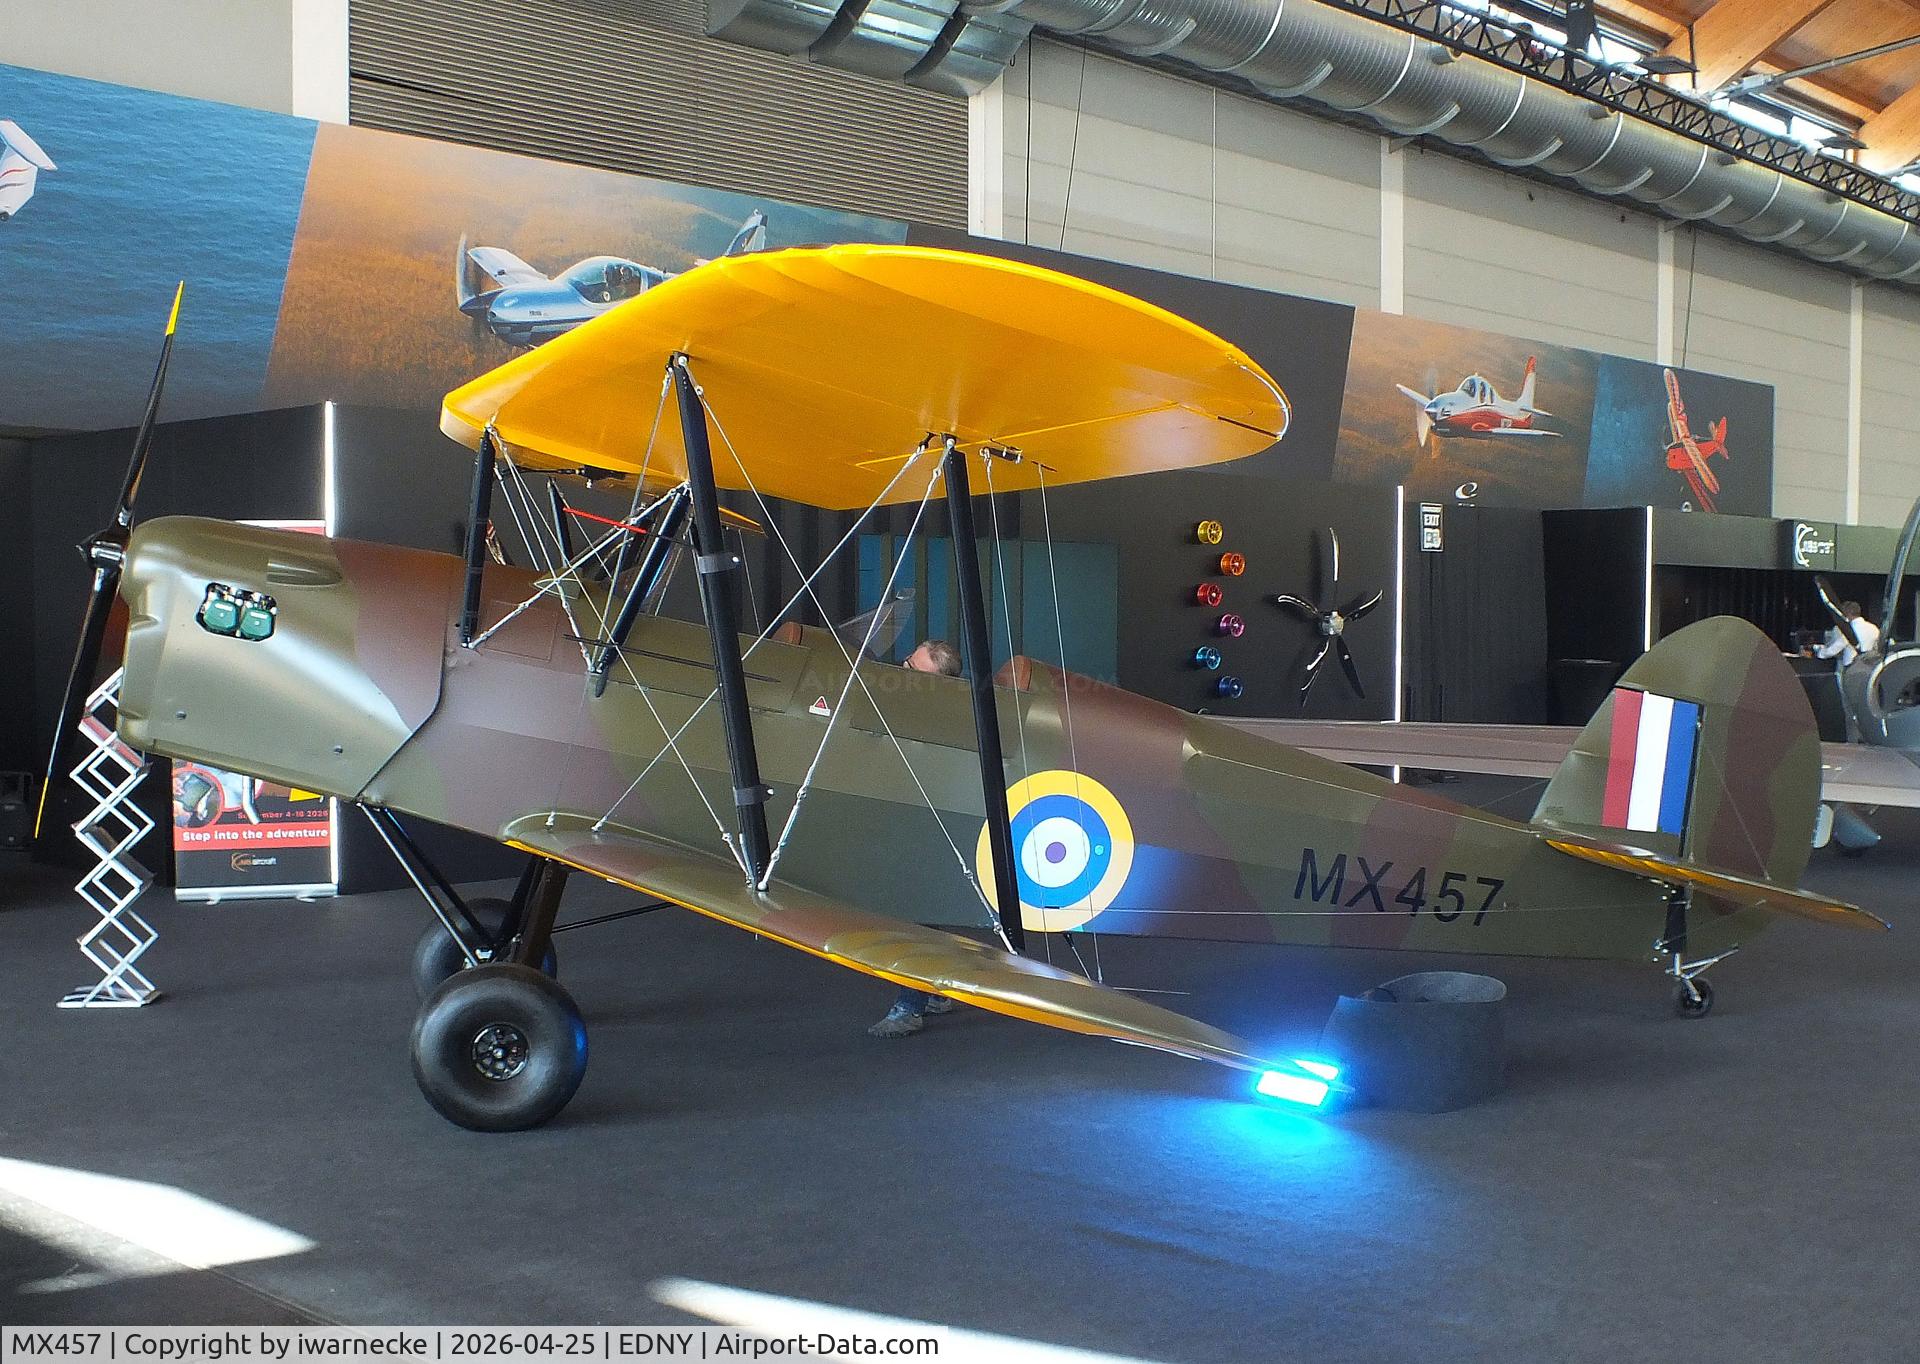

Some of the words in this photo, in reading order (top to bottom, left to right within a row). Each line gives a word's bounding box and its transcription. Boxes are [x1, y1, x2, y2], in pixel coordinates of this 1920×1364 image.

[238, 811, 283, 820] Sember
[182, 831, 211, 842] Step
[214, 830, 239, 841] into
[242, 829, 263, 840] the
[266, 828, 328, 839] adventure
[1294, 848, 1505, 927] MX457
